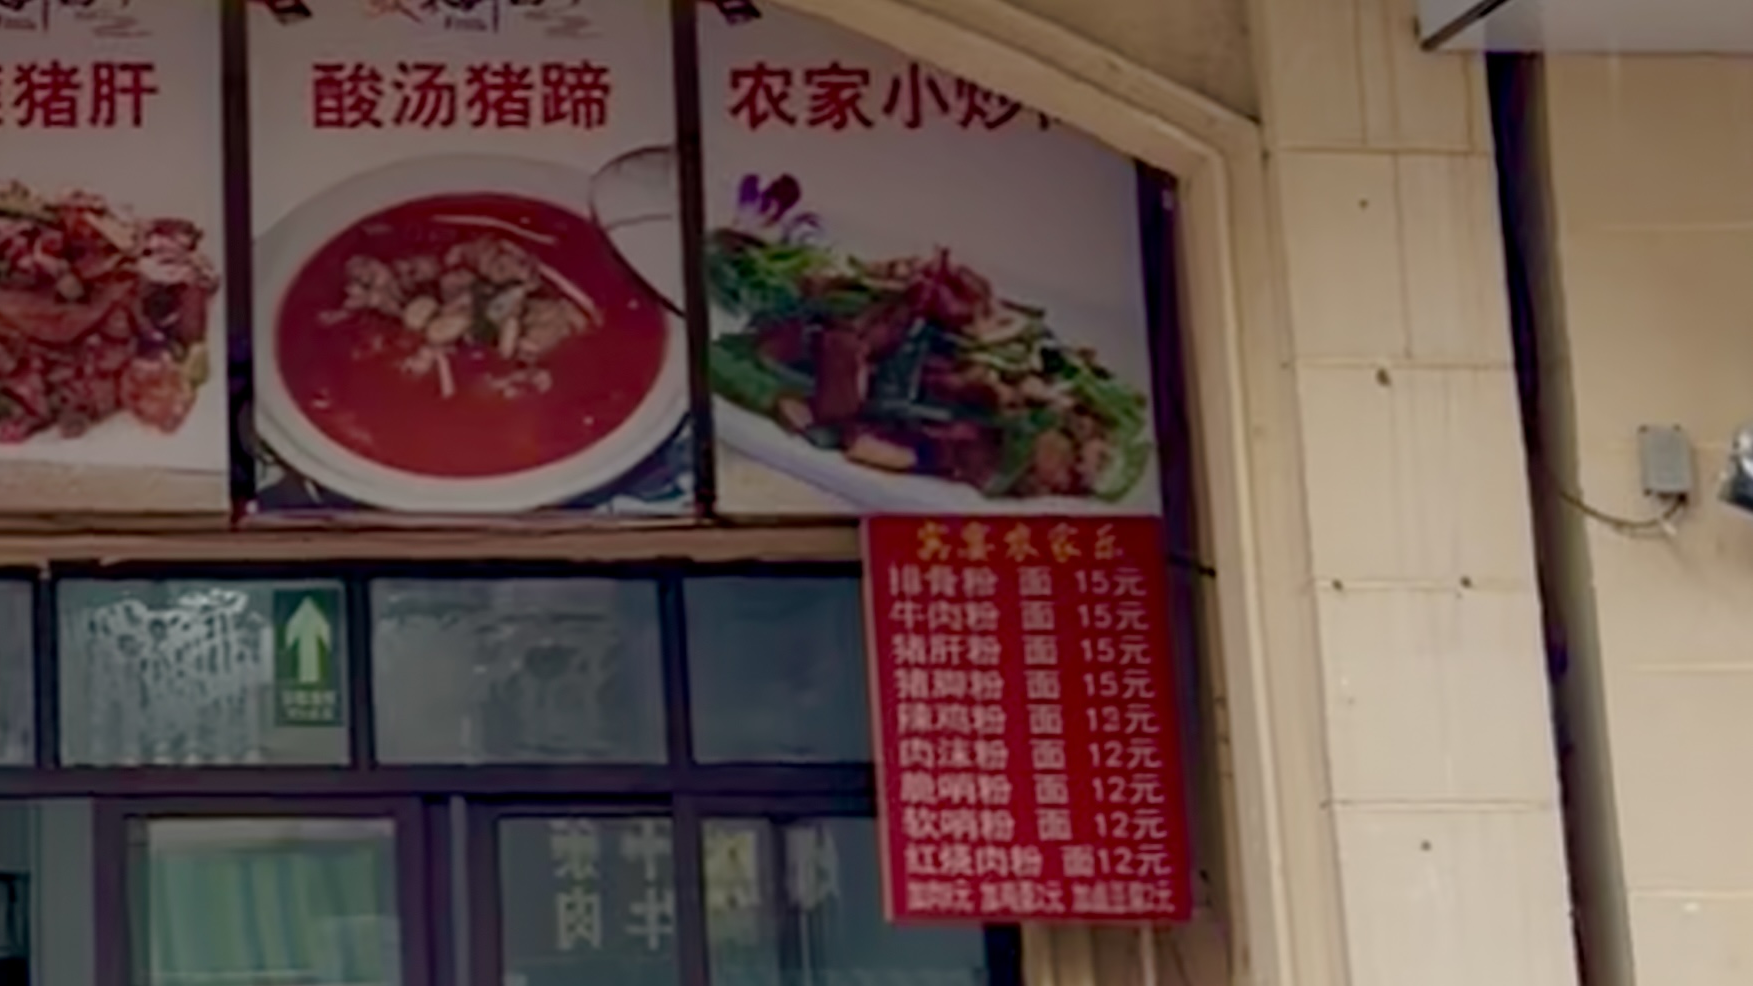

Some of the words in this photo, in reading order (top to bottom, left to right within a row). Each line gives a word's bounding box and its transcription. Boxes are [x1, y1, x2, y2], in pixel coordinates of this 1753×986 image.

[312, 60, 612, 129] 酸汤猪蹄
[729, 61, 1050, 130] 农家小炒
[889, 564, 999, 597] 排骨粉
[1075, 568, 1147, 597] 15元
[890, 601, 1000, 631] 牛肉粉
[1077, 602, 1149, 631] 15元
[893, 634, 1002, 666] 猪肝粉
[1080, 636, 1152, 666] 15元
[1083, 670, 1156, 700] 15元
[1089, 738, 1164, 769] 12元
[1092, 774, 1167, 805] 12元
[1095, 809, 1169, 841] 12元
